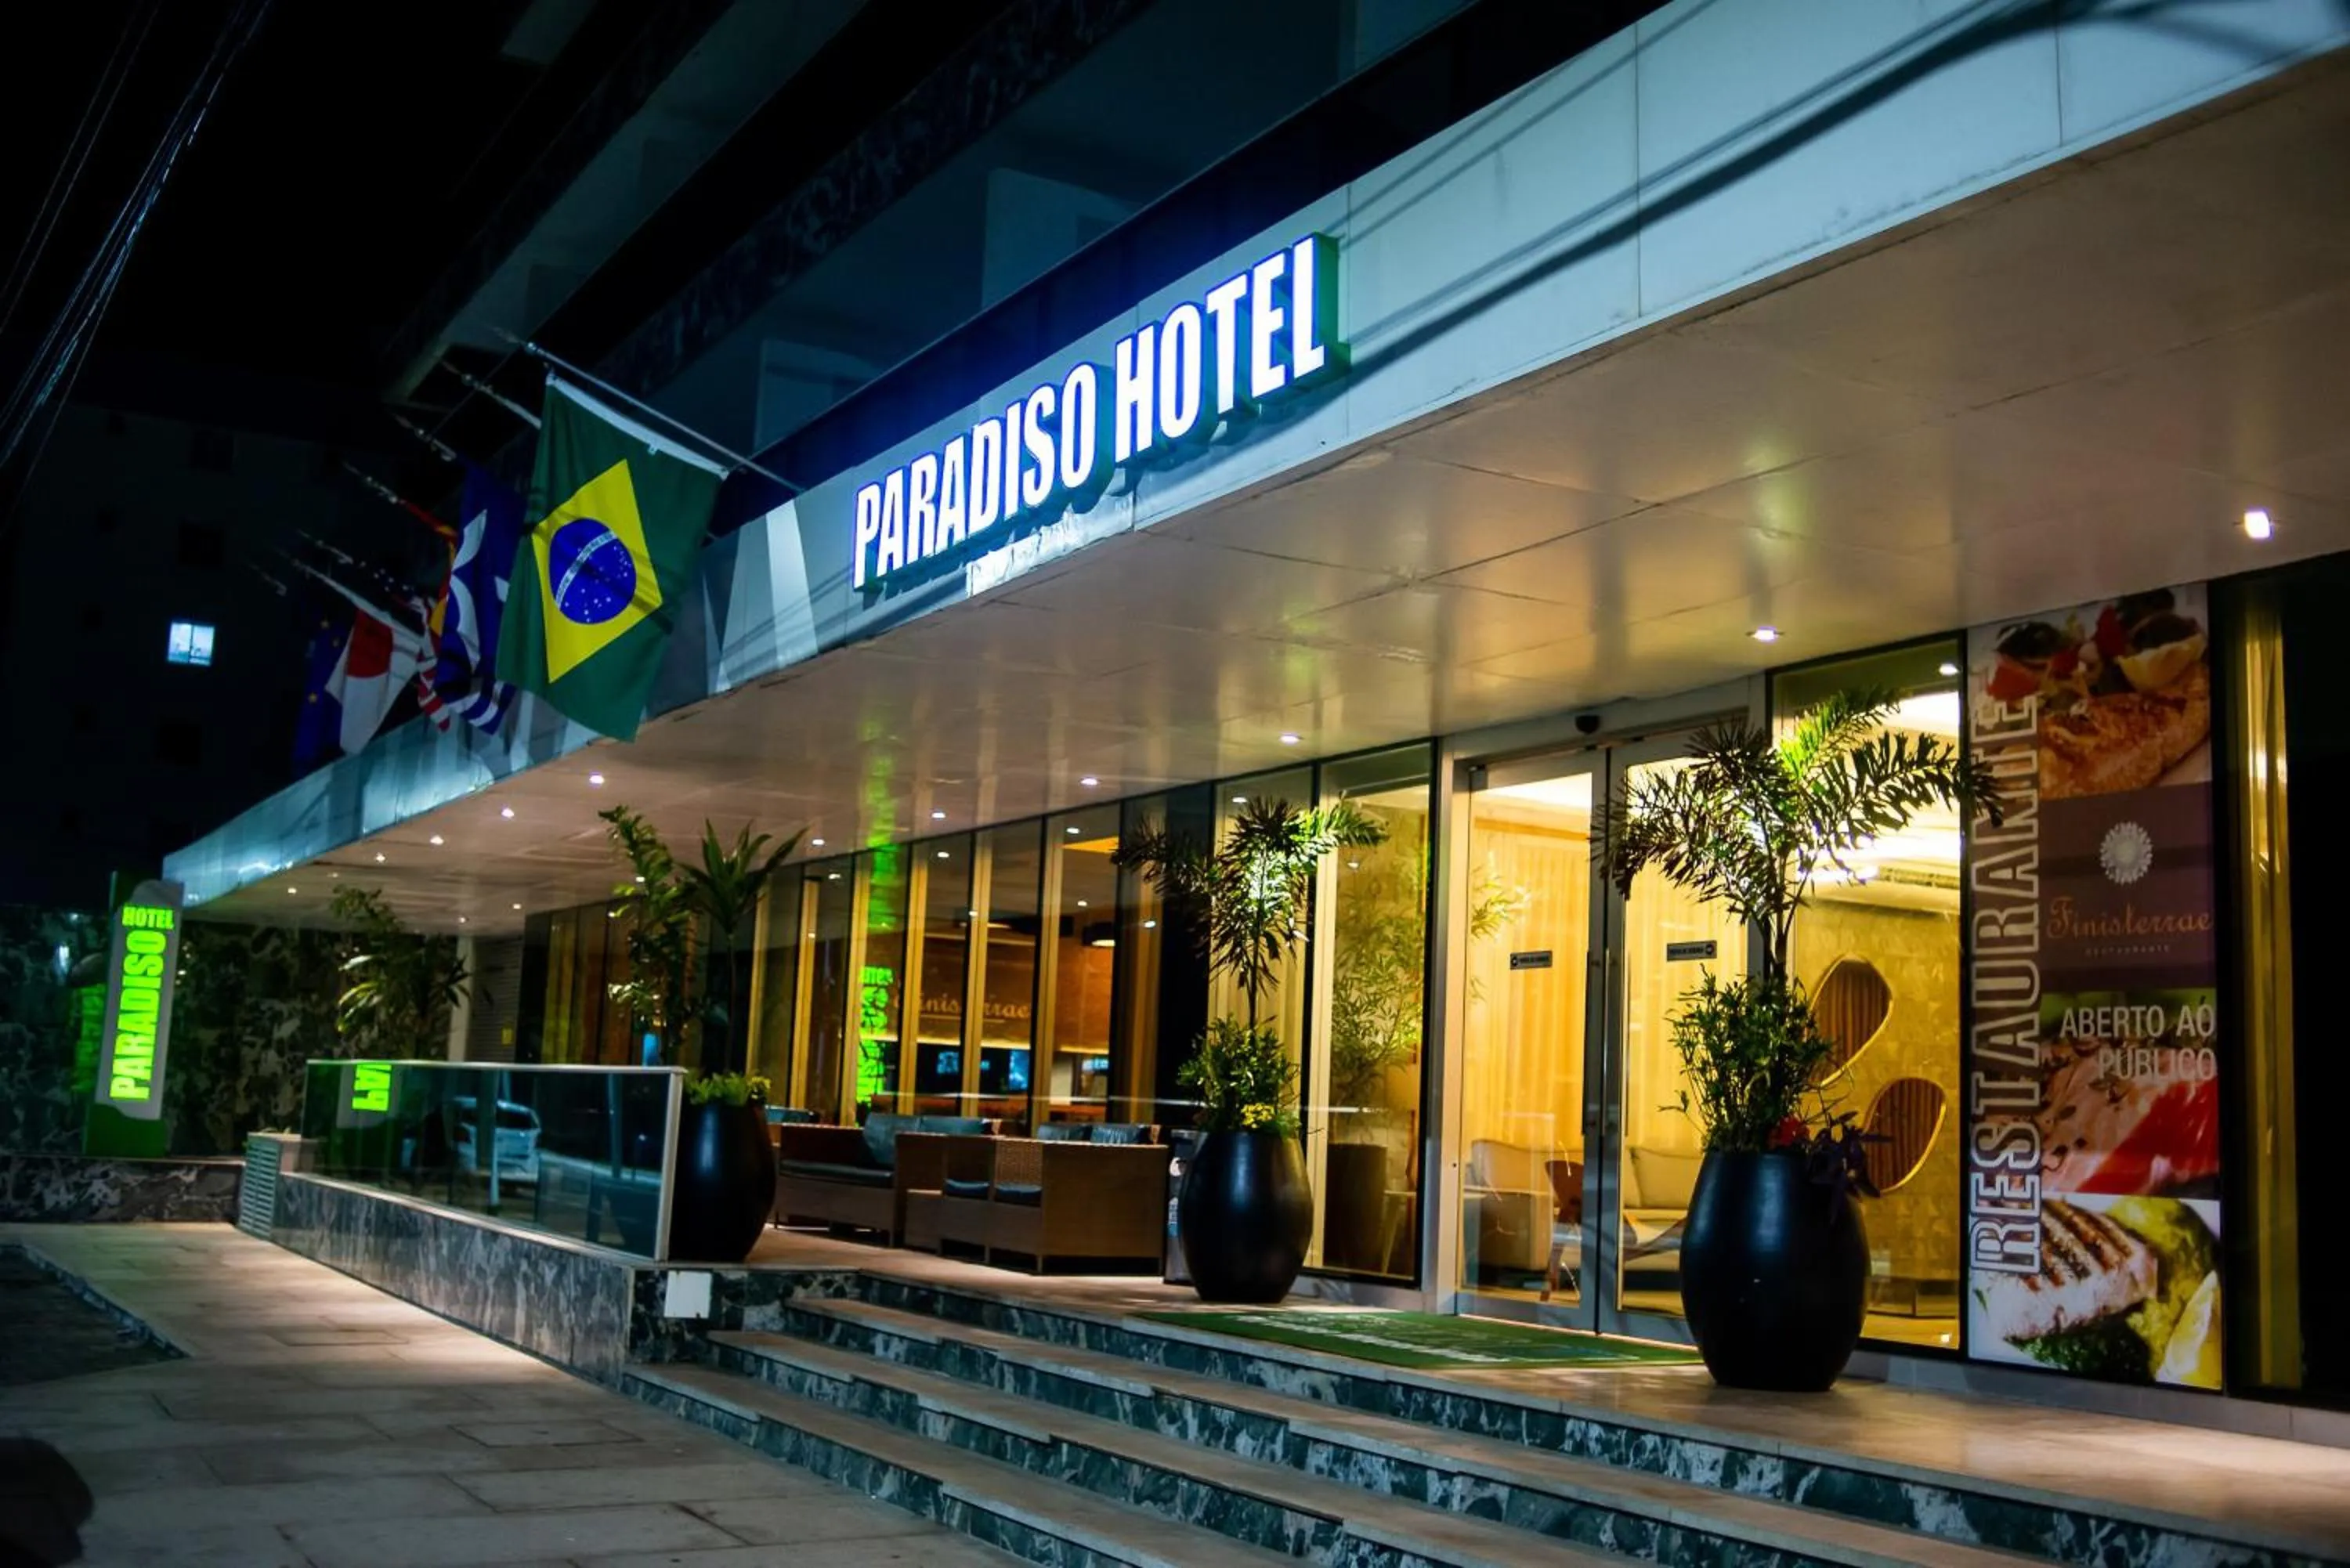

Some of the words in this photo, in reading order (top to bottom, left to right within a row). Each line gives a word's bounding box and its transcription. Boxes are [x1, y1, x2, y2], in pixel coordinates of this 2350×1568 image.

[854, 364, 1097, 589] PARADISO
[1115, 236, 1325, 464] HOTEL
[122, 905, 174, 930] HOTEL
[2046, 895, 2212, 938] Finisterrae
[110, 930, 166, 1100] PARADISO
[1971, 693, 2041, 1274] RESTAURANTE
[2059, 1005, 2164, 1039] ABERTO
